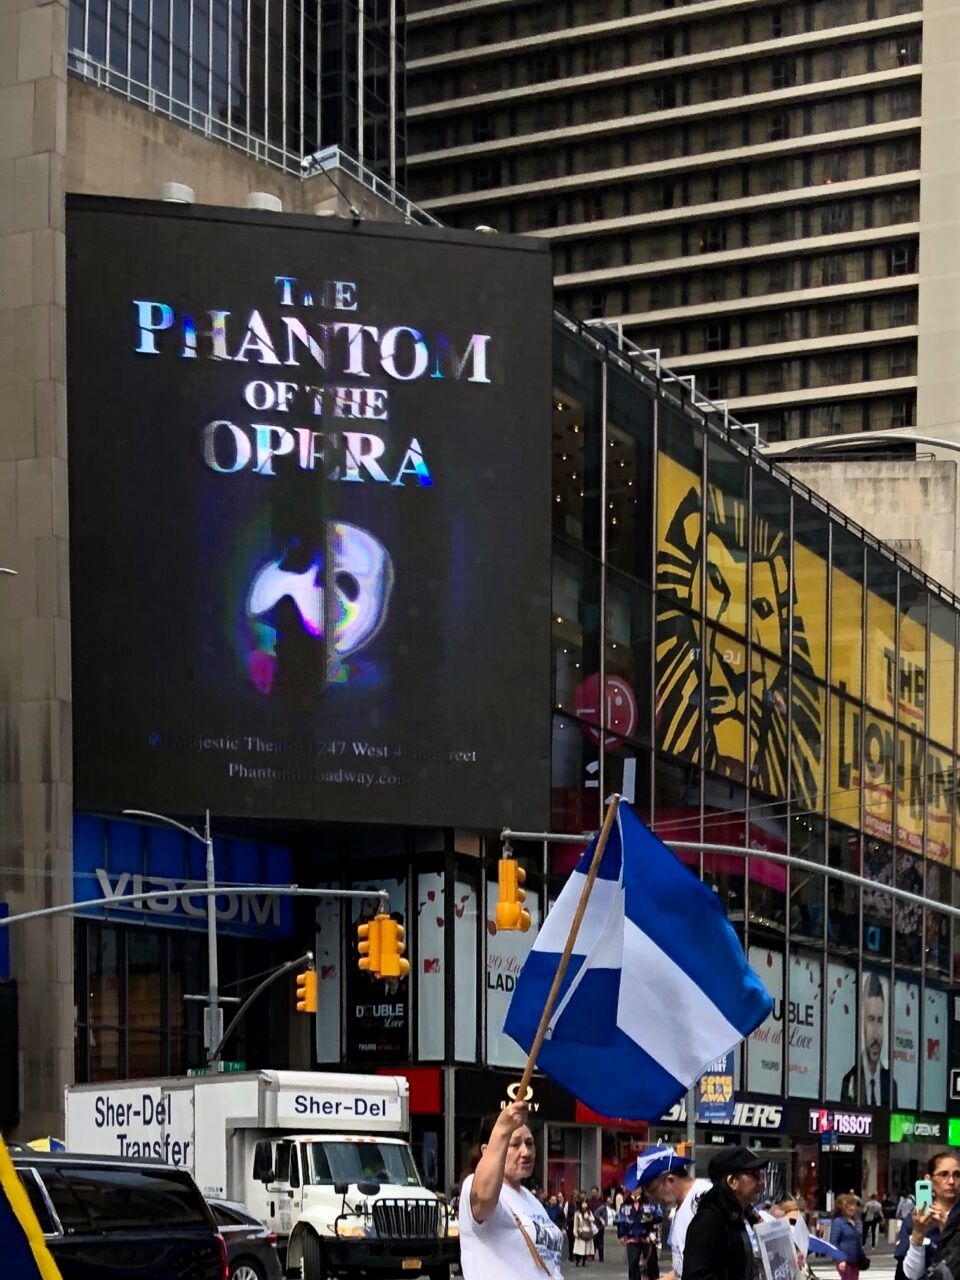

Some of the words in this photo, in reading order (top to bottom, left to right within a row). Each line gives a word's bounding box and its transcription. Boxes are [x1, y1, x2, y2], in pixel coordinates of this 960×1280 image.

[133, 299, 491, 384] PHANTOM
[245, 380, 298, 413] OF
[305, 385, 388, 420] THE
[203, 420, 434, 488] OPERA
[884, 646, 926, 709] THE
[353, 743, 389, 758] West
[838, 681, 905, 793] LION
[96, 868, 281, 928] VIACOM
[772, 998, 814, 1028] UBLE
[787, 1026, 814, 1050] Love
[94, 1093, 171, 1128] Sher-Del
[294, 1094, 387, 1117] Sher-Del
[834, 1113, 872, 1135] TISSOT
[116, 1133, 190, 1168] Transfer
